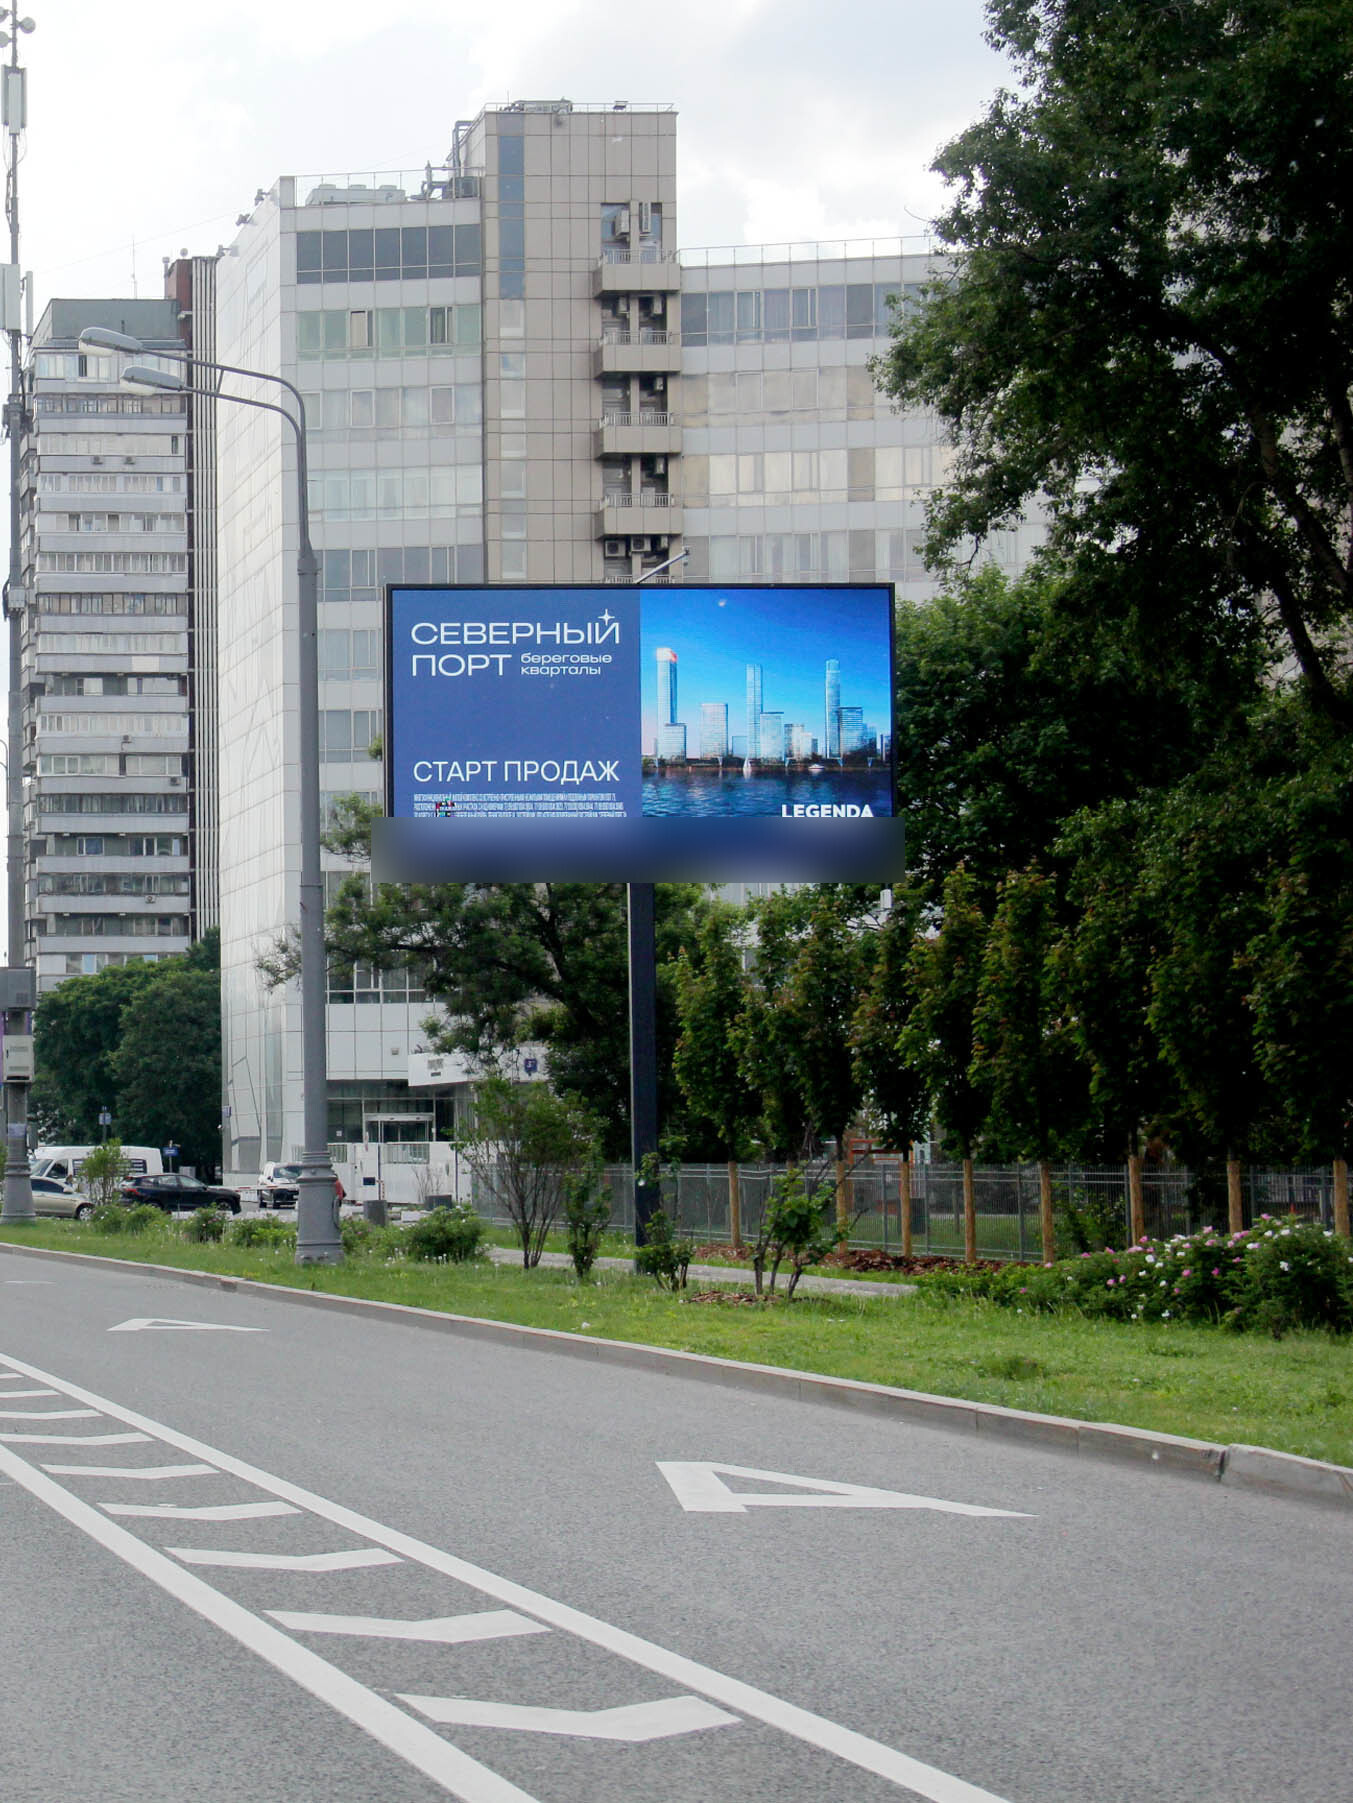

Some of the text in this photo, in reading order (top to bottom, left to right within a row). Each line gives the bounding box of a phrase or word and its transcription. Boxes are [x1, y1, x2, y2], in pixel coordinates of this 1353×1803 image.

[411, 611, 620, 645] СЕВЕРНЫЙ
[412, 654, 512, 677] ПОРТ
[520, 652, 613, 666] береговые
[520, 666, 601, 678] кварталы
[413, 760, 620, 786] СТАРТ ПРОДАЖ
[781, 804, 874, 818] LEGENDA
